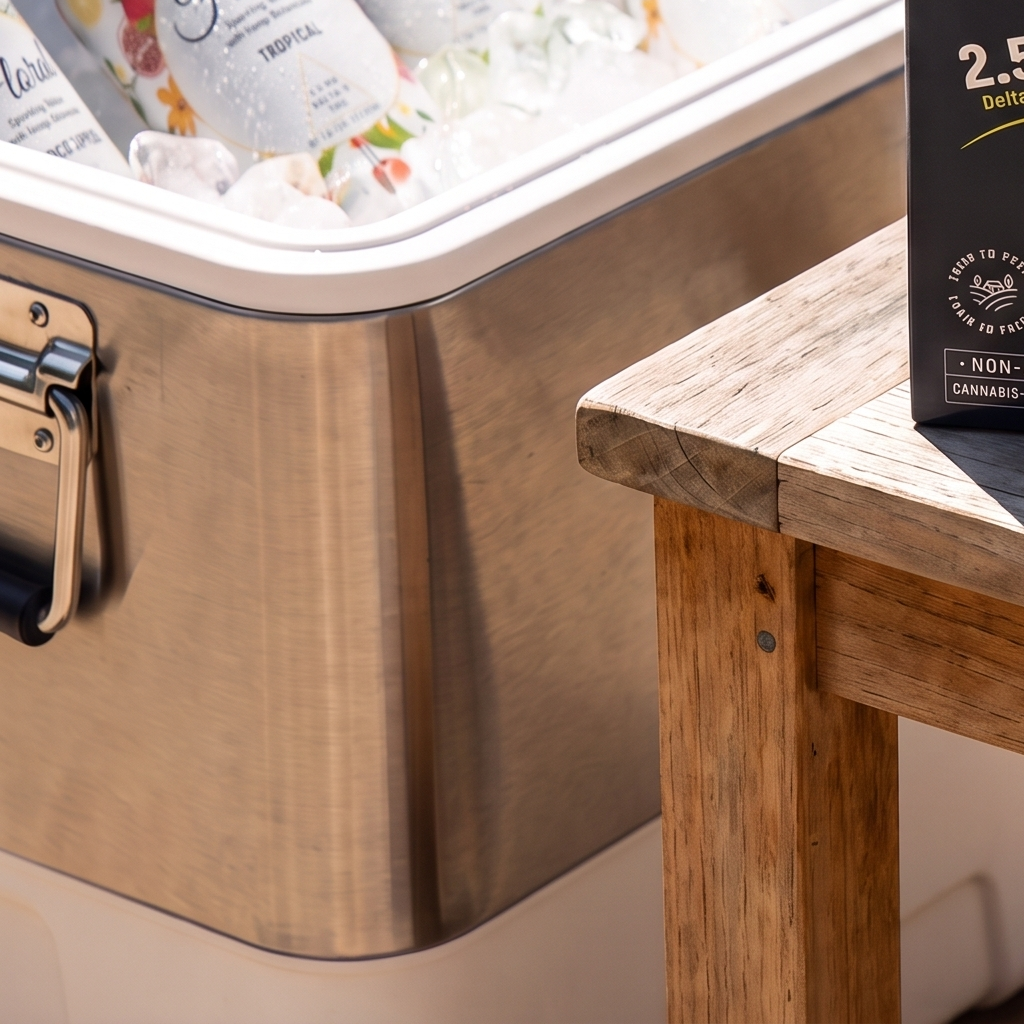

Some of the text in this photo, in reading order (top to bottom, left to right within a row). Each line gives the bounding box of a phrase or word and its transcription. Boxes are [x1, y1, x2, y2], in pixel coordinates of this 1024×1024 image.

[258, 21, 323, 63] TROPICAL
[0, 38, 57, 99] loral
[979, 249, 995, 259] TO
